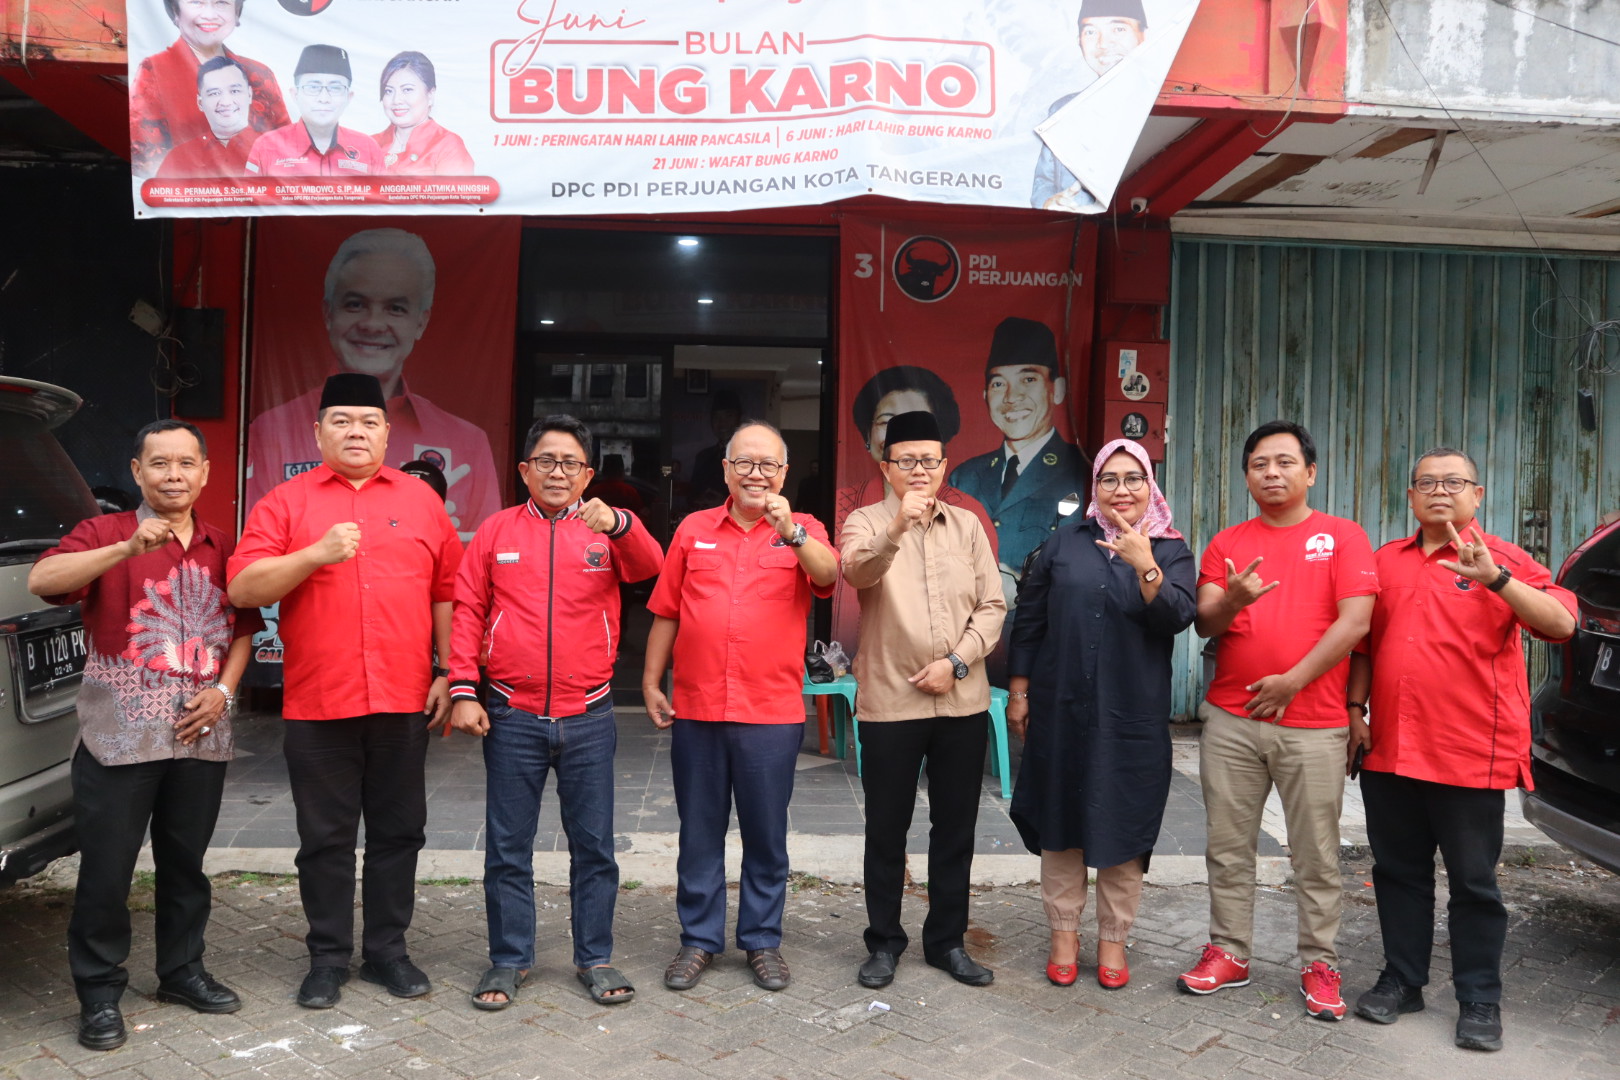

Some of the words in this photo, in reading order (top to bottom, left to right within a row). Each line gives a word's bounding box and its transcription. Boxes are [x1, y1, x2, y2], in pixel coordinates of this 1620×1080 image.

[502, 0, 646, 77] Juni
[685, 31, 805, 55] BULAN
[509, 67, 707, 116] BUNG
[729, 60, 978, 115] KARNO
[493, 134, 499, 147] 1
[501, 134, 532, 147] JUNI
[541, 134, 624, 147] PERINGATAN
[624, 134, 657, 147] HARI
[659, 134, 698, 147] LAHIR
[700, 131, 771, 147] PANCASILA
[785, 130, 794, 142] 6
[796, 127, 827, 141] JUNI
[835, 119, 866, 137] HARI
[867, 119, 905, 136] LAHIR
[907, 125, 944, 137] BUNG
[946, 126, 993, 140] KARNO
[652, 157, 666, 170] 21
[668, 157, 699, 170] JUNI
[708, 155, 753, 169] WAFAT
[755, 152, 791, 167] BUNG
[793, 148, 839, 164] KARNO
[149, 187, 173, 196] ANDRI
[174, 187, 183, 196] S.
[184, 187, 223, 197] PERMANA,
[275, 185, 300, 194] GATOT
[301, 185, 336, 195] WIBOWO,
[379, 184, 422, 193] ANGGRAINI
[422, 184, 457, 193] JATMIKA
[457, 184, 490, 193] NINGSIH
[551, 182, 596, 198] DPC
[603, 182, 639, 198] PDI
[646, 175, 797, 197] PERJUANGAN
[804, 166, 860, 189] KOTA
[866, 163, 1003, 190] TANGERANG
[853, 253, 874, 279] 3
[968, 253, 997, 269] PDI
[968, 270, 1083, 287] PERJUANGAN
[27, 642, 36, 671] B
[43, 634, 70, 666] 1120
[1600, 646, 1613, 671] B
